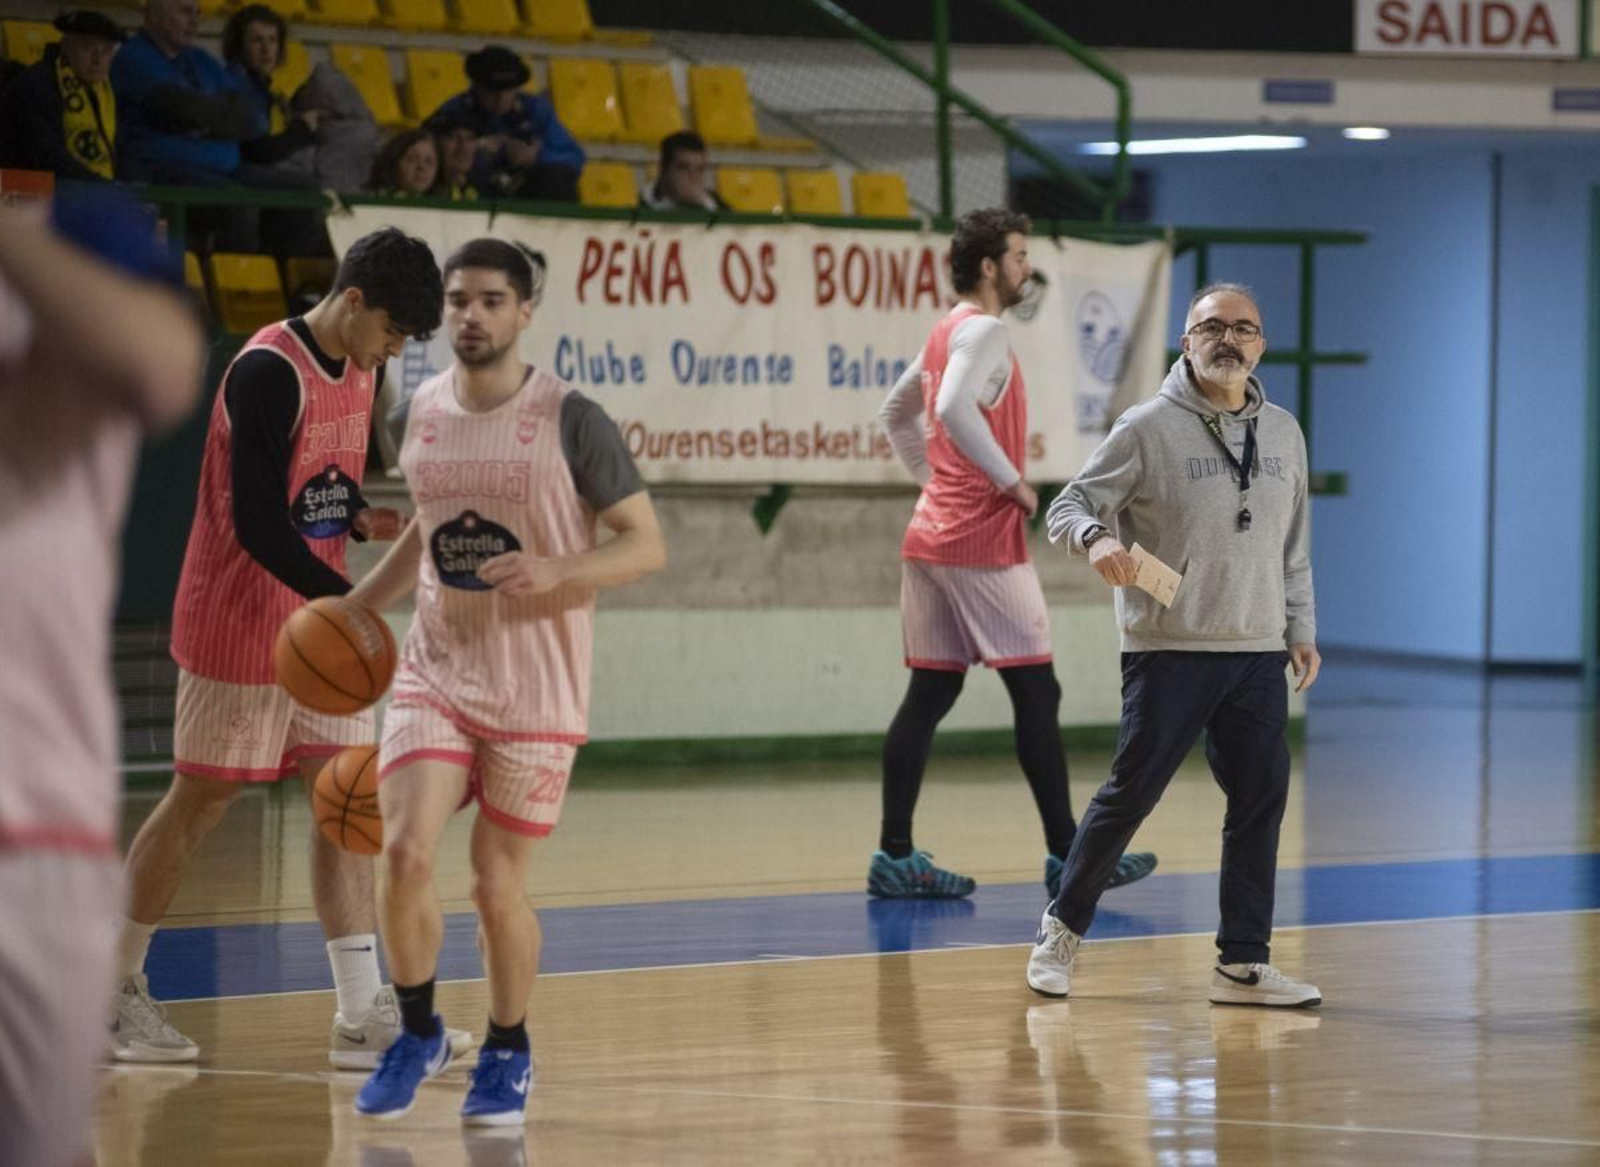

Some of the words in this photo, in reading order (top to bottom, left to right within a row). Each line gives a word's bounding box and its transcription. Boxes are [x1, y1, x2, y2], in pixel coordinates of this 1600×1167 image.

[1376, 0, 1558, 45] SAIDA
[577, 229, 689, 305] PEÑA
[721, 241, 776, 304] OS
[554, 335, 646, 384] Clube
[671, 340, 793, 385] Ourense
[416, 461, 531, 502] 32005
[439, 533, 505, 552] Estrella
